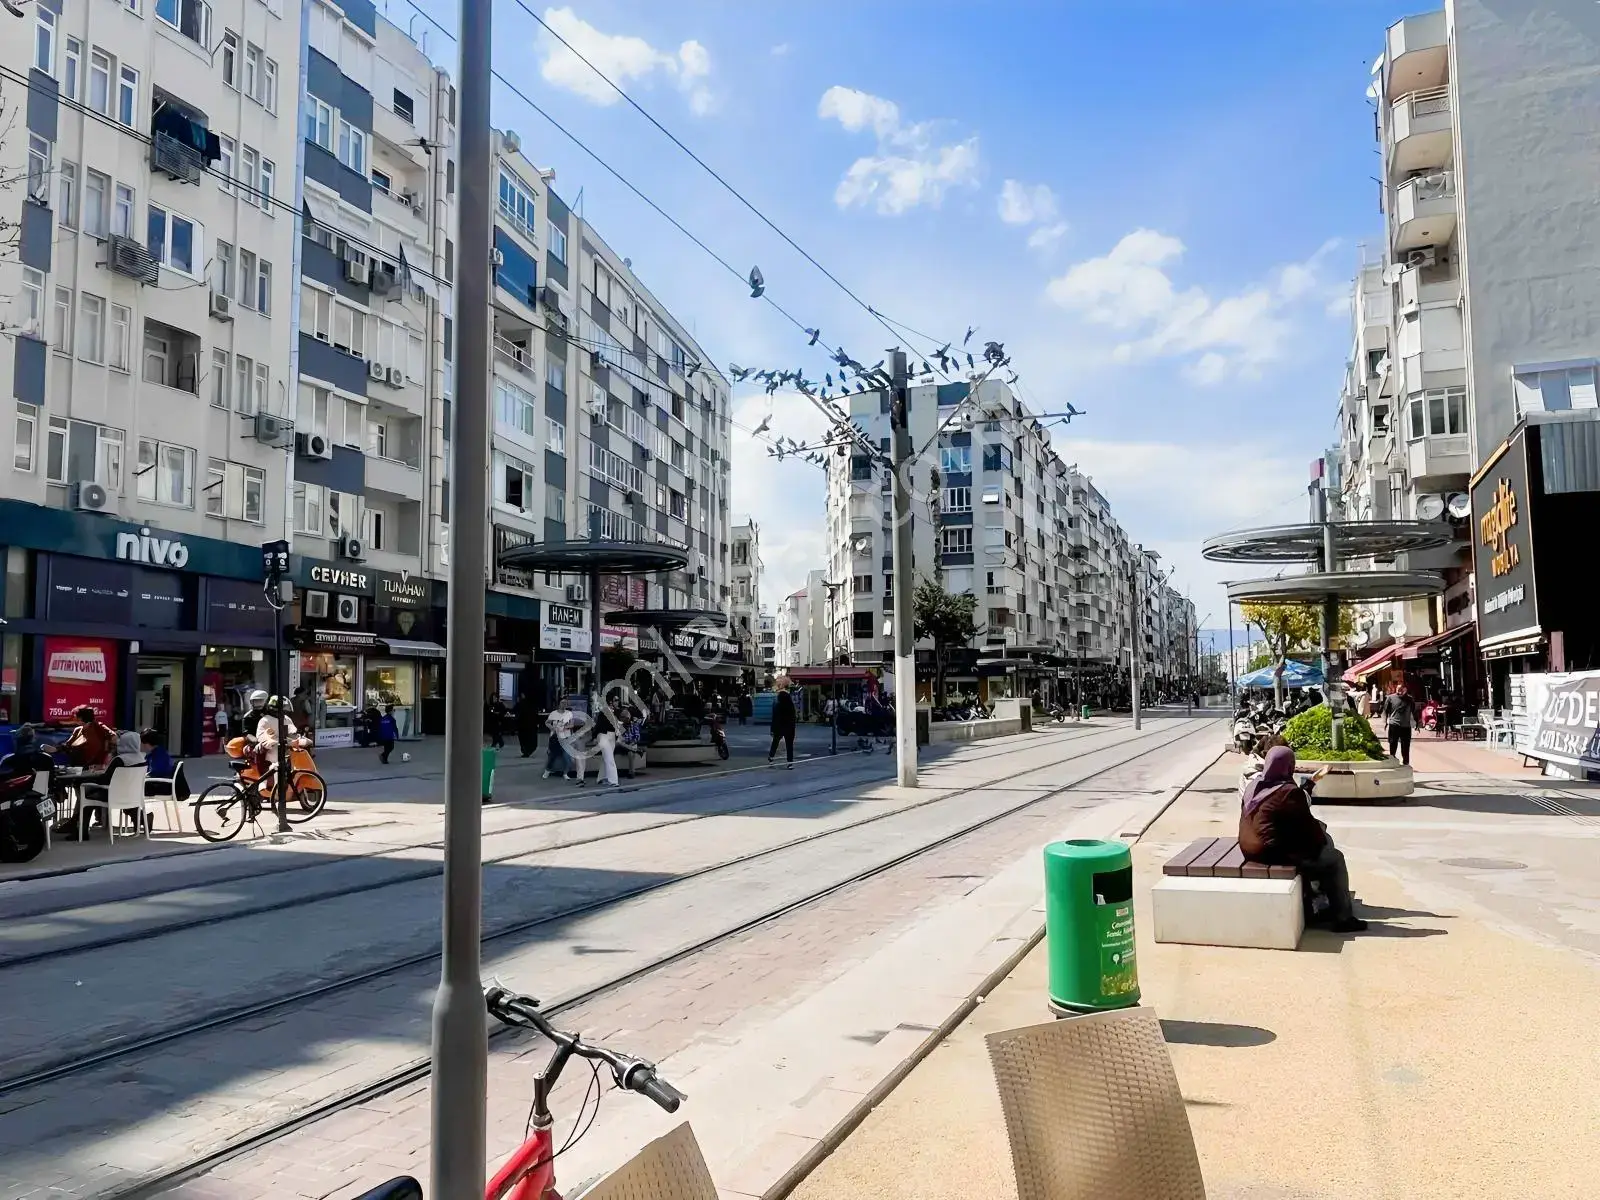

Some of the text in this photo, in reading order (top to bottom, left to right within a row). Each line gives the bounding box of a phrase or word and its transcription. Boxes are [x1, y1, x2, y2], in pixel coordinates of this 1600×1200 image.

[116, 527, 188, 568] nivo
[311, 566, 367, 589] CEVHER
[382, 579, 425, 597] TUNAHAN
